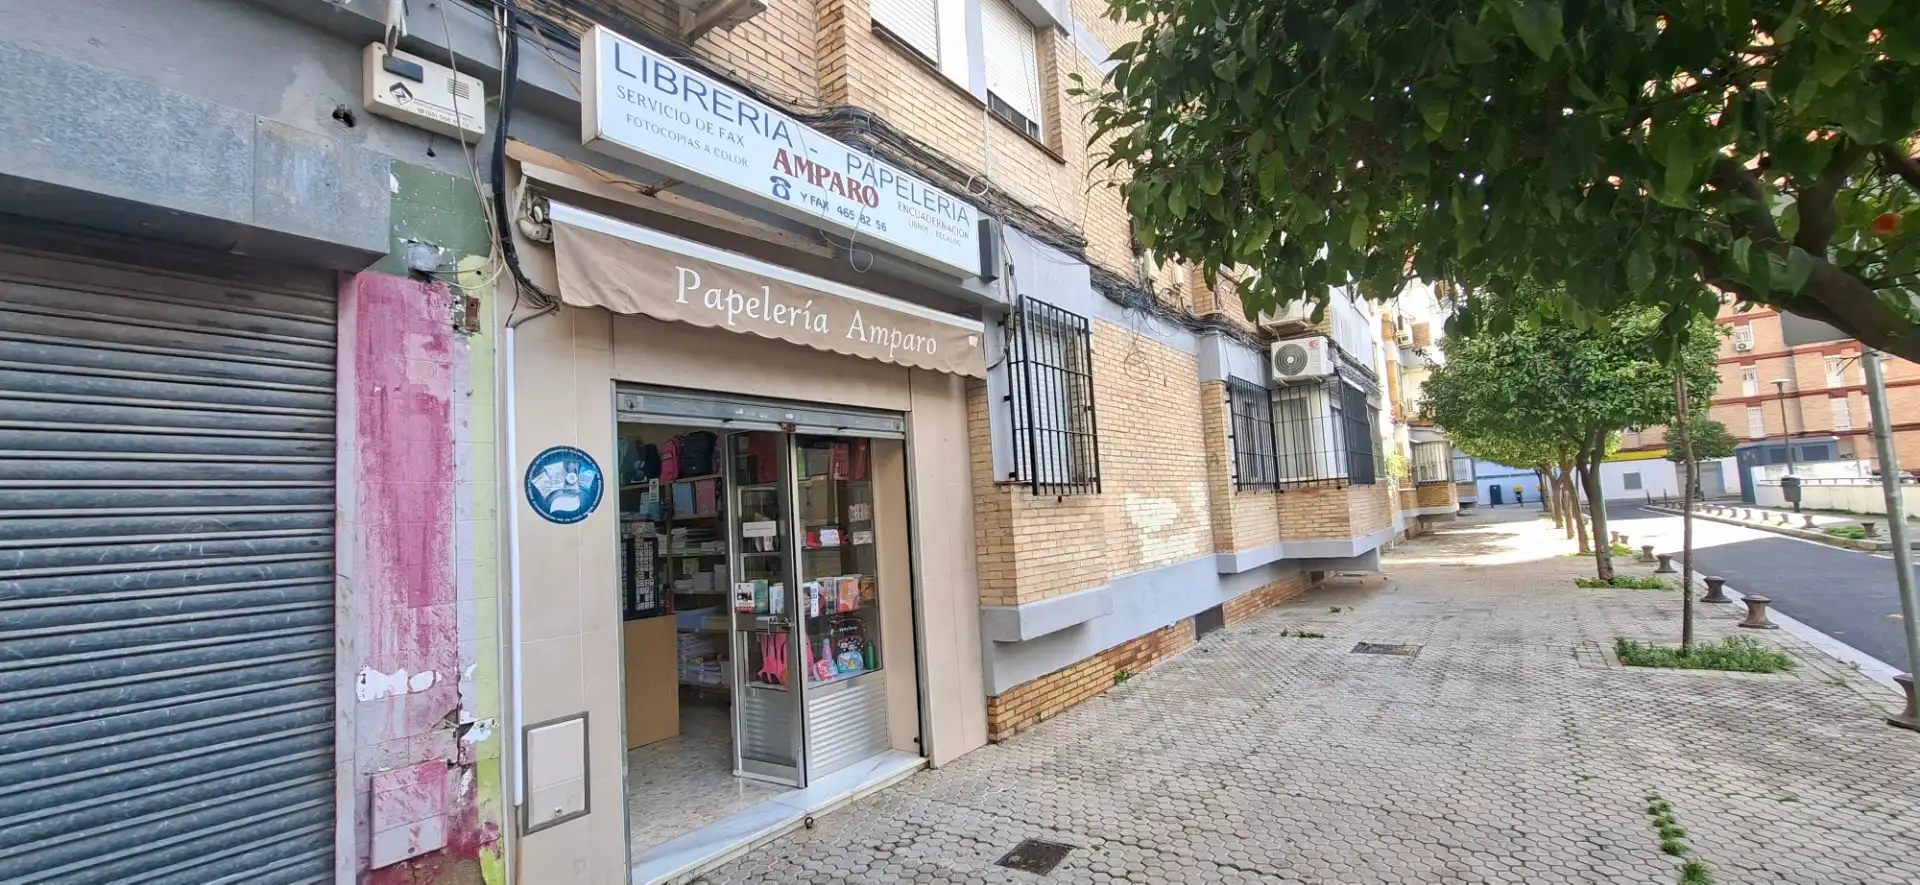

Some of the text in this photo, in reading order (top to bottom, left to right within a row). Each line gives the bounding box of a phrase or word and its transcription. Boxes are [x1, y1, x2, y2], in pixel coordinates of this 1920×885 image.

[614, 41, 794, 148] LIBRERIA
[846, 152, 970, 227] PAPELERIA
[616, 84, 746, 147] SERVICIO DE FAX
[626, 113, 749, 167] FOTOCOPIAS A COLOR
[772, 148, 880, 208] AMPARO
[800, 191, 887, 232] Y FAX 465 82 56
[675, 265, 937, 358] Papelería Amparo
